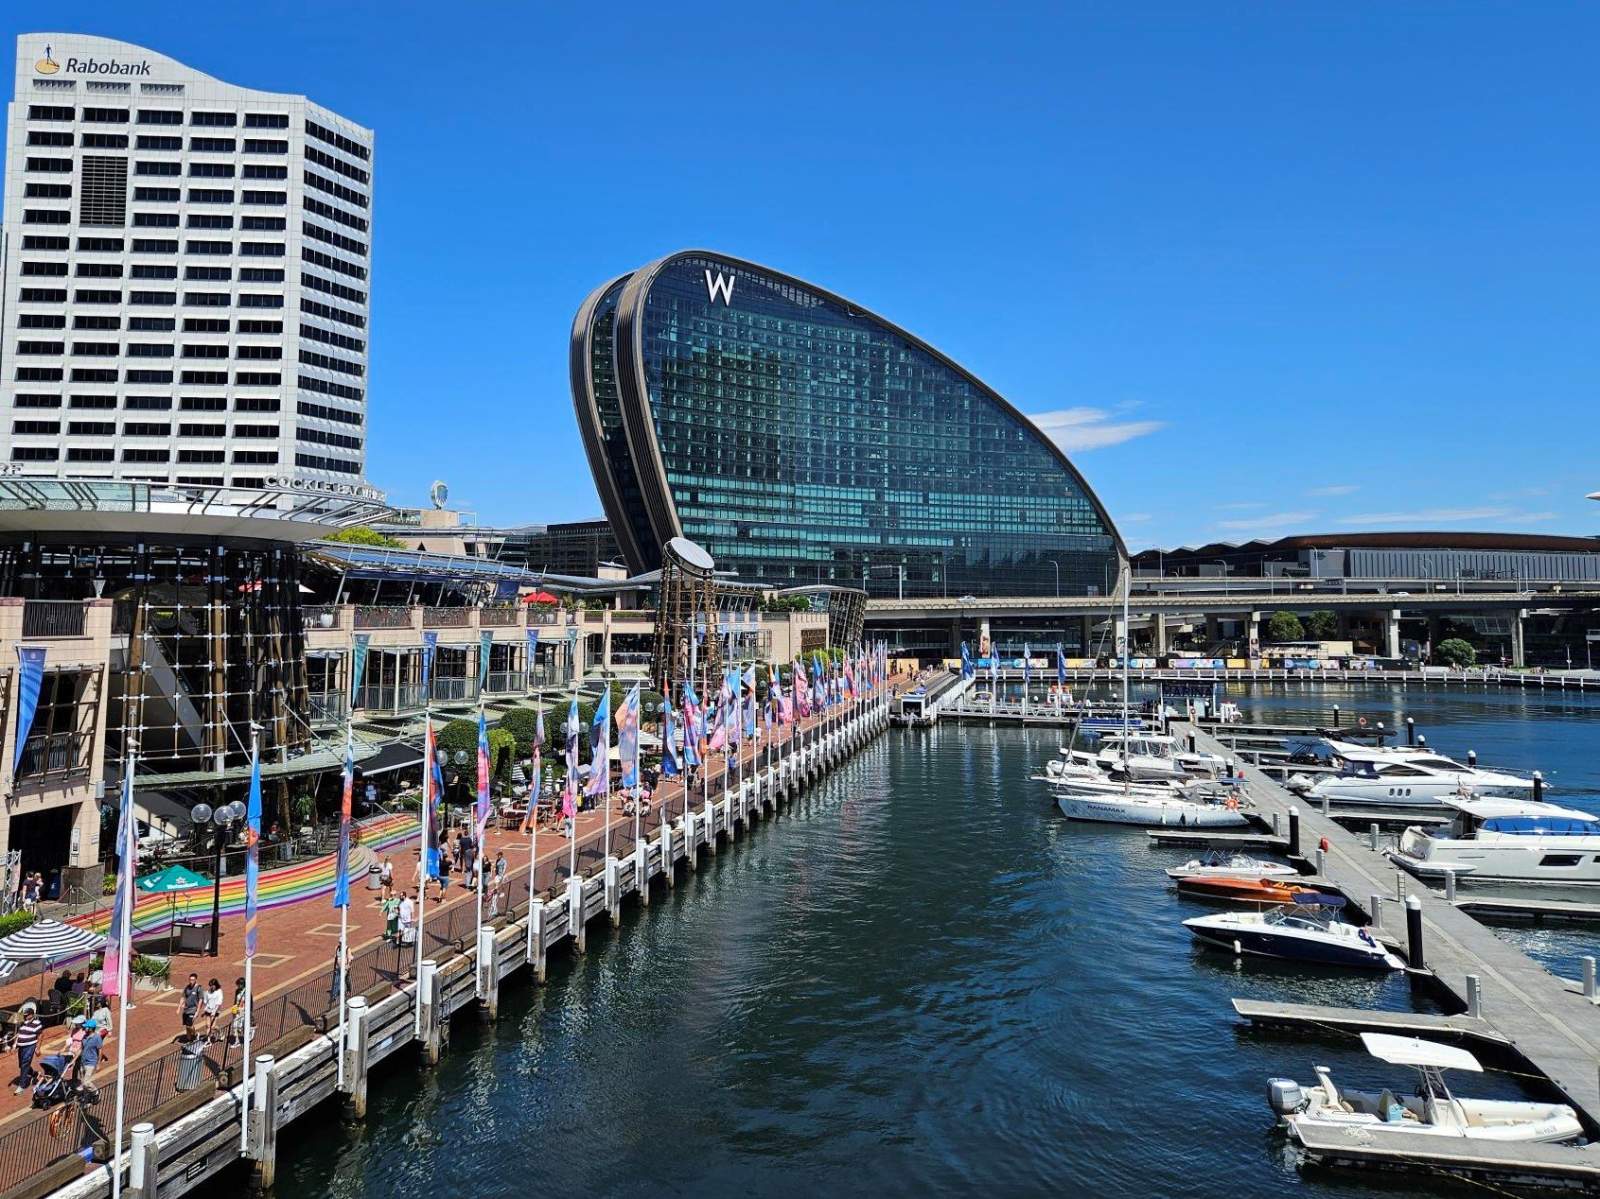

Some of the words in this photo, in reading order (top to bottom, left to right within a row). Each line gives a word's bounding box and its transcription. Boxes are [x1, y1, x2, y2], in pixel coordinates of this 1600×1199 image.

[66, 58, 152, 76] Rabobank
[704, 269, 736, 307] W
[263, 475, 335, 494] COCKLE
